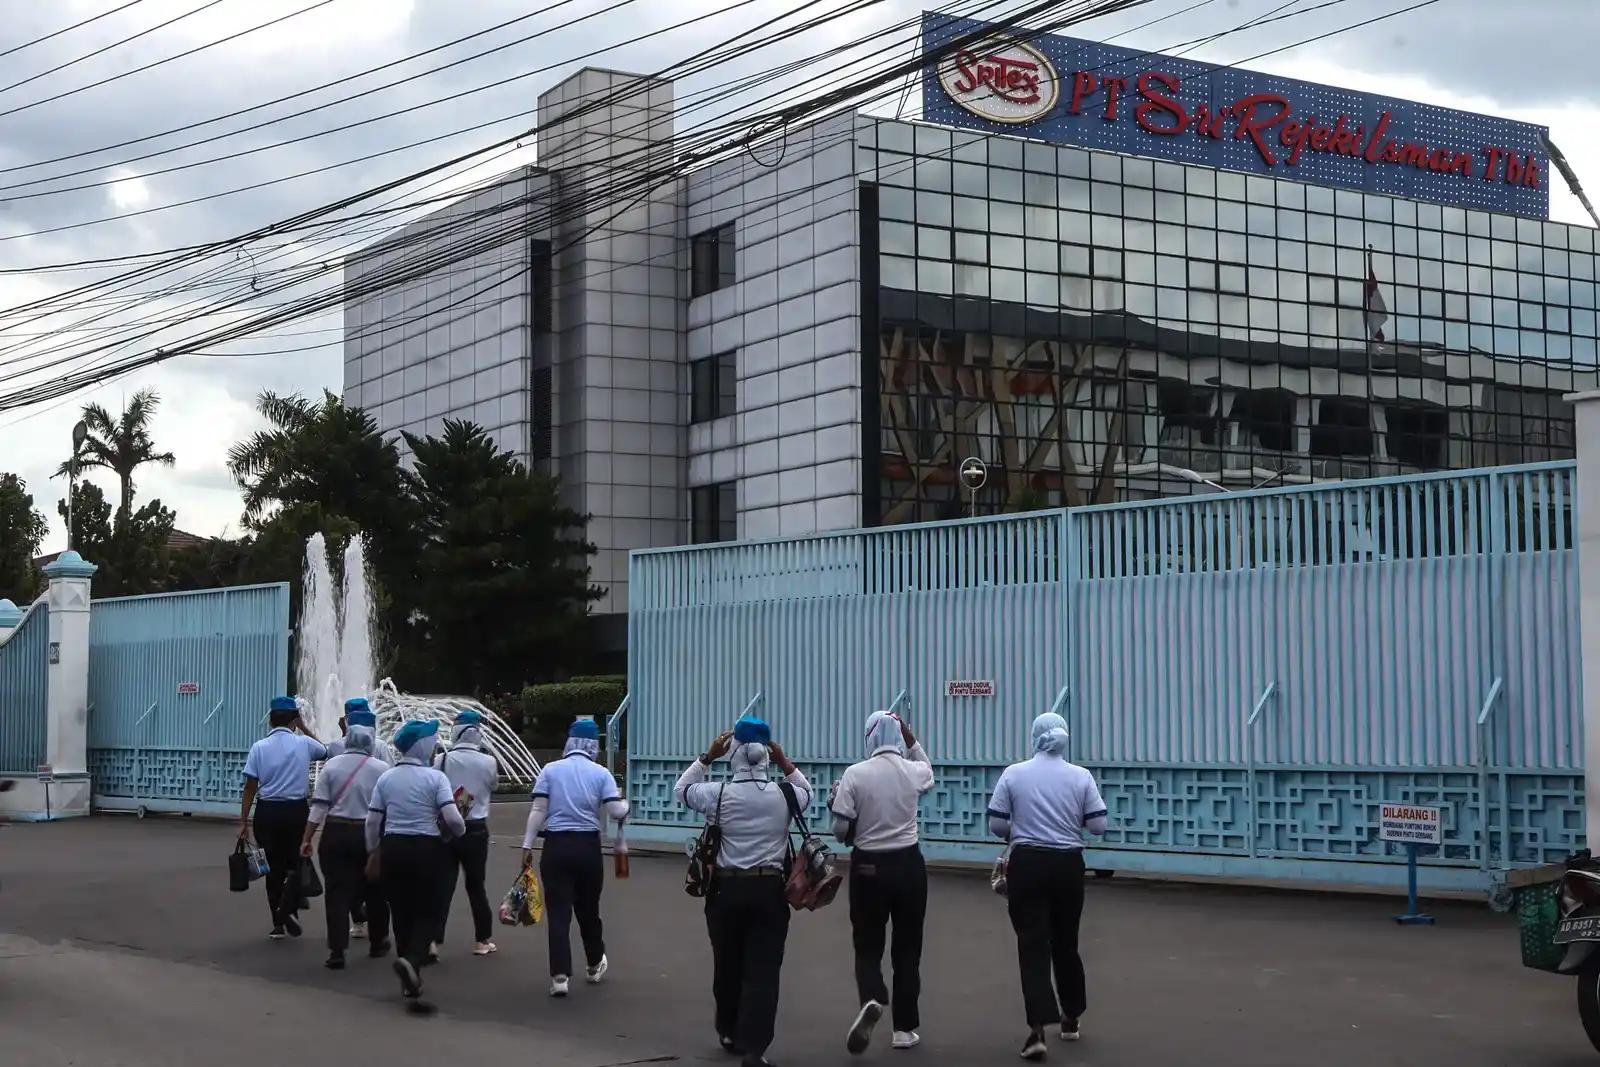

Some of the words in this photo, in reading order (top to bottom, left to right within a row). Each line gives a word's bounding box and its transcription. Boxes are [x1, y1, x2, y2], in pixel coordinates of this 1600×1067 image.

[1067, 71, 1128, 120] PT
[1482, 146, 1541, 188] Tbk
[1383, 807, 1428, 820] DILARANG
[1560, 921, 1572, 932] AD
